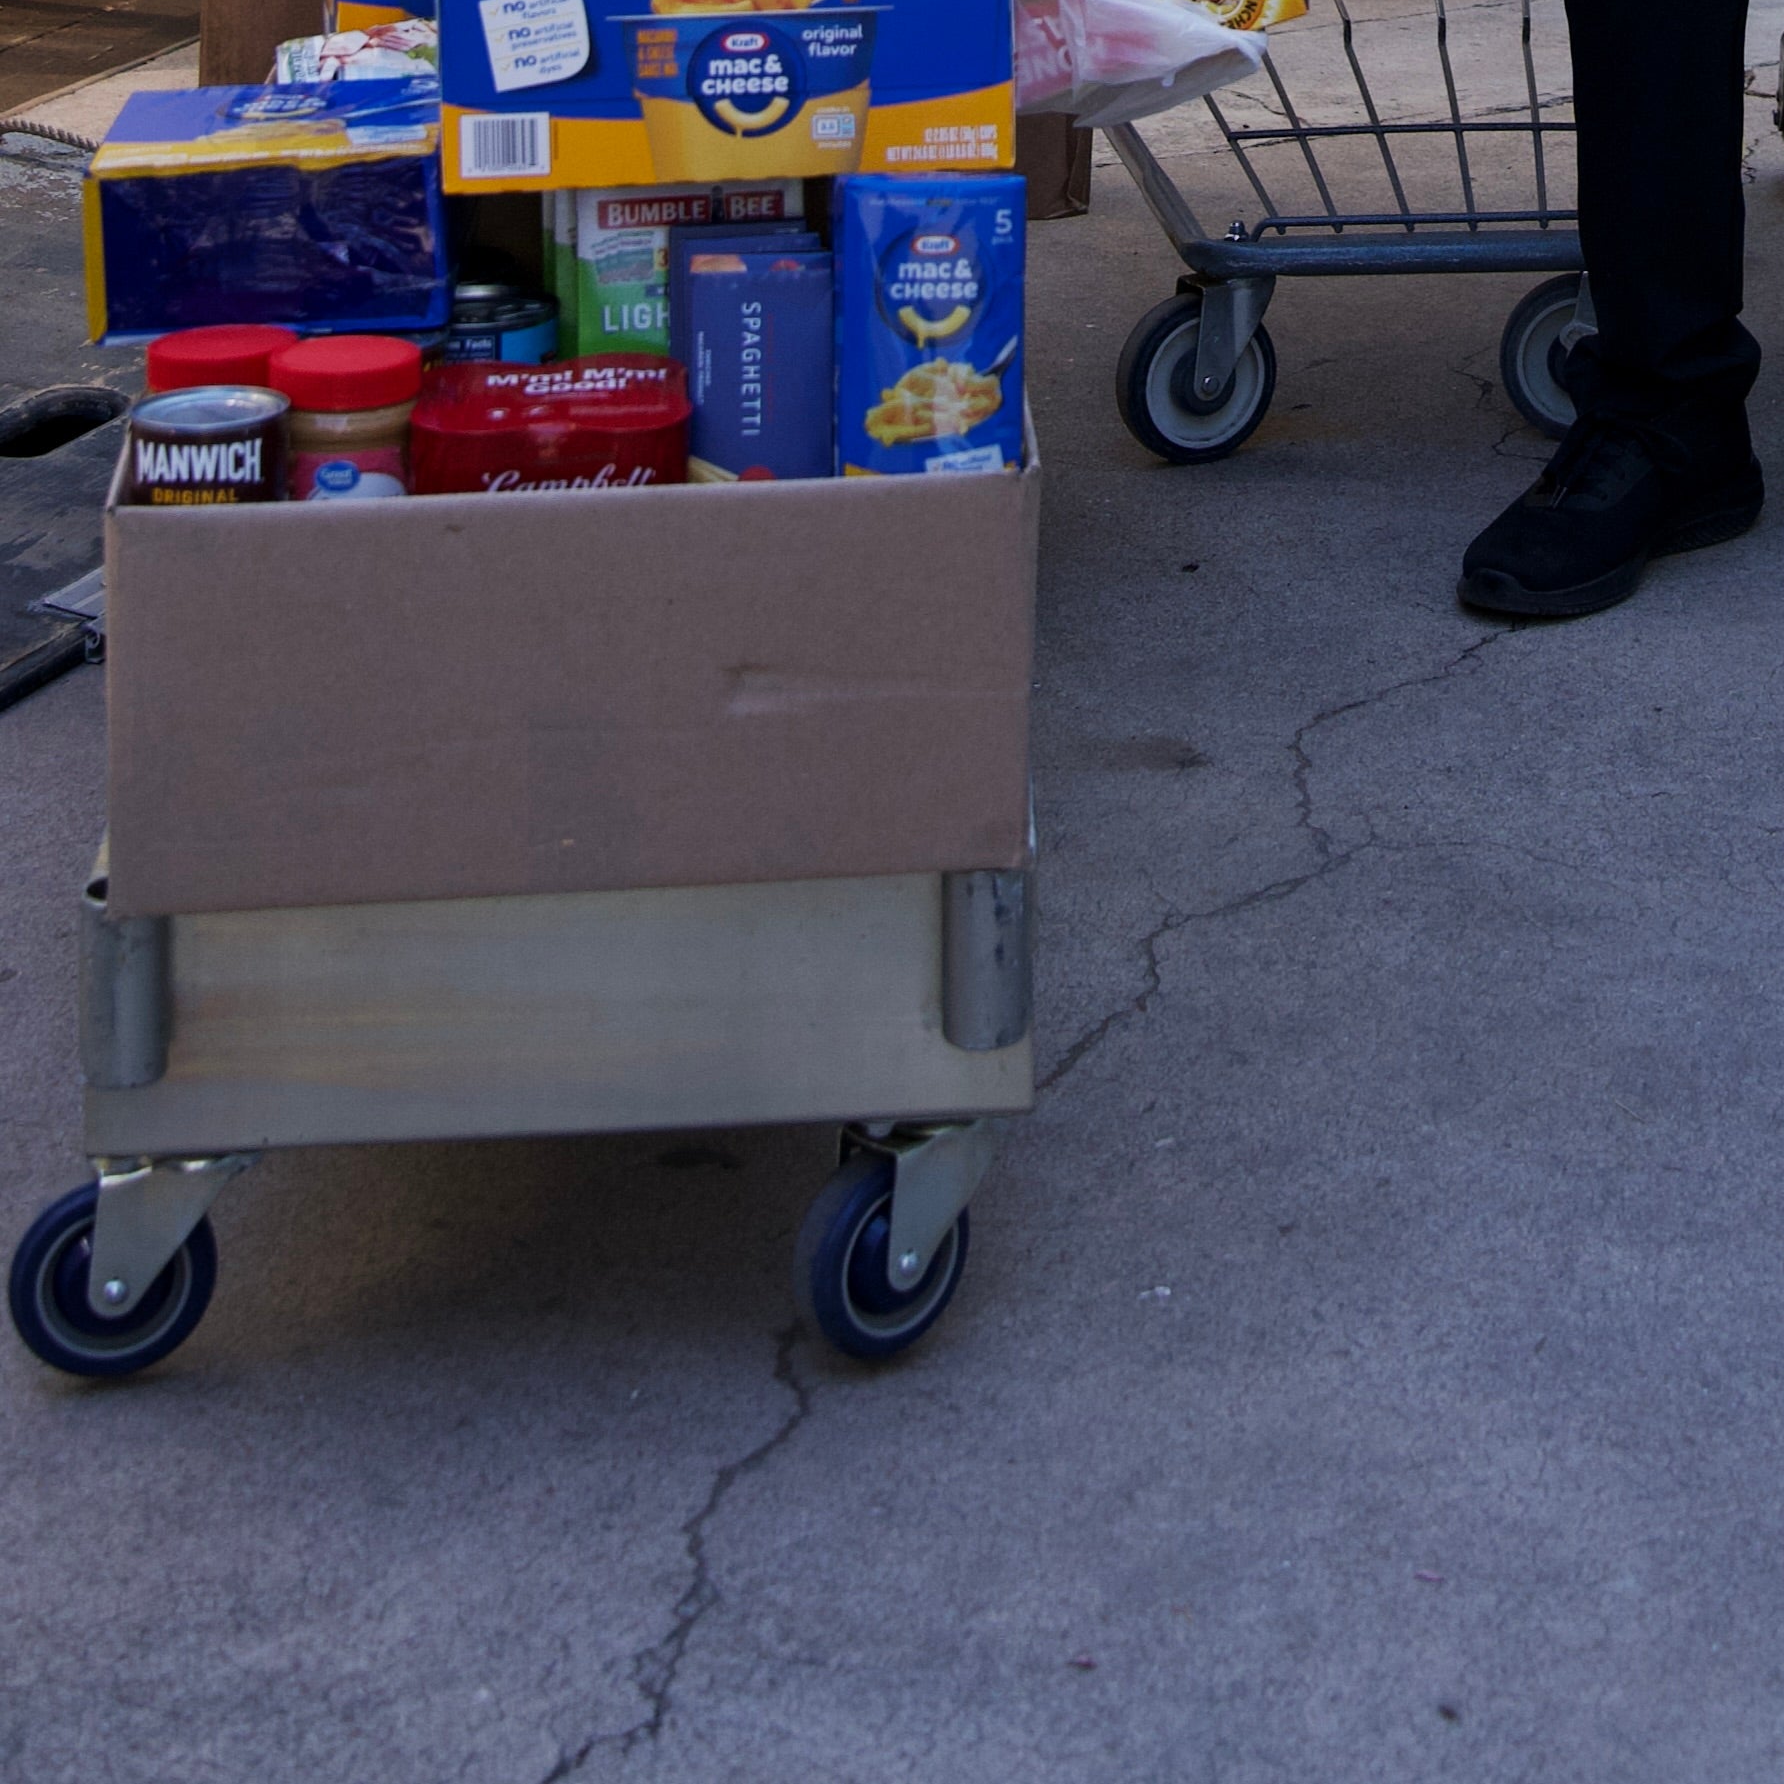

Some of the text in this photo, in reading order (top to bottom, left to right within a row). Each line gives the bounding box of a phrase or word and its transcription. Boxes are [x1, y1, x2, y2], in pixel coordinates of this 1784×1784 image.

[503, 0, 526, 15] no
[522, 7, 557, 20] flavors
[508, 21, 575, 42] no artificial
[510, 30, 578, 52] preservatives
[801, 23, 864, 43] original
[730, 36, 761, 49] Kraft
[807, 42, 858, 58] flavor
[513, 49, 581, 70] no artificial
[708, 53, 783, 76] mac &
[607, 194, 776, 227] BUMBLE BEE
[994, 208, 1013, 235] 5
[897, 258, 973, 281] mac &
[582, 366, 669, 383] M'm!
[740, 301, 762, 438] SPAGHETTI
[523, 377, 629, 396] Good!
[135, 437, 264, 483] MANWICH
[152, 487, 239, 505] ORIGINAL
